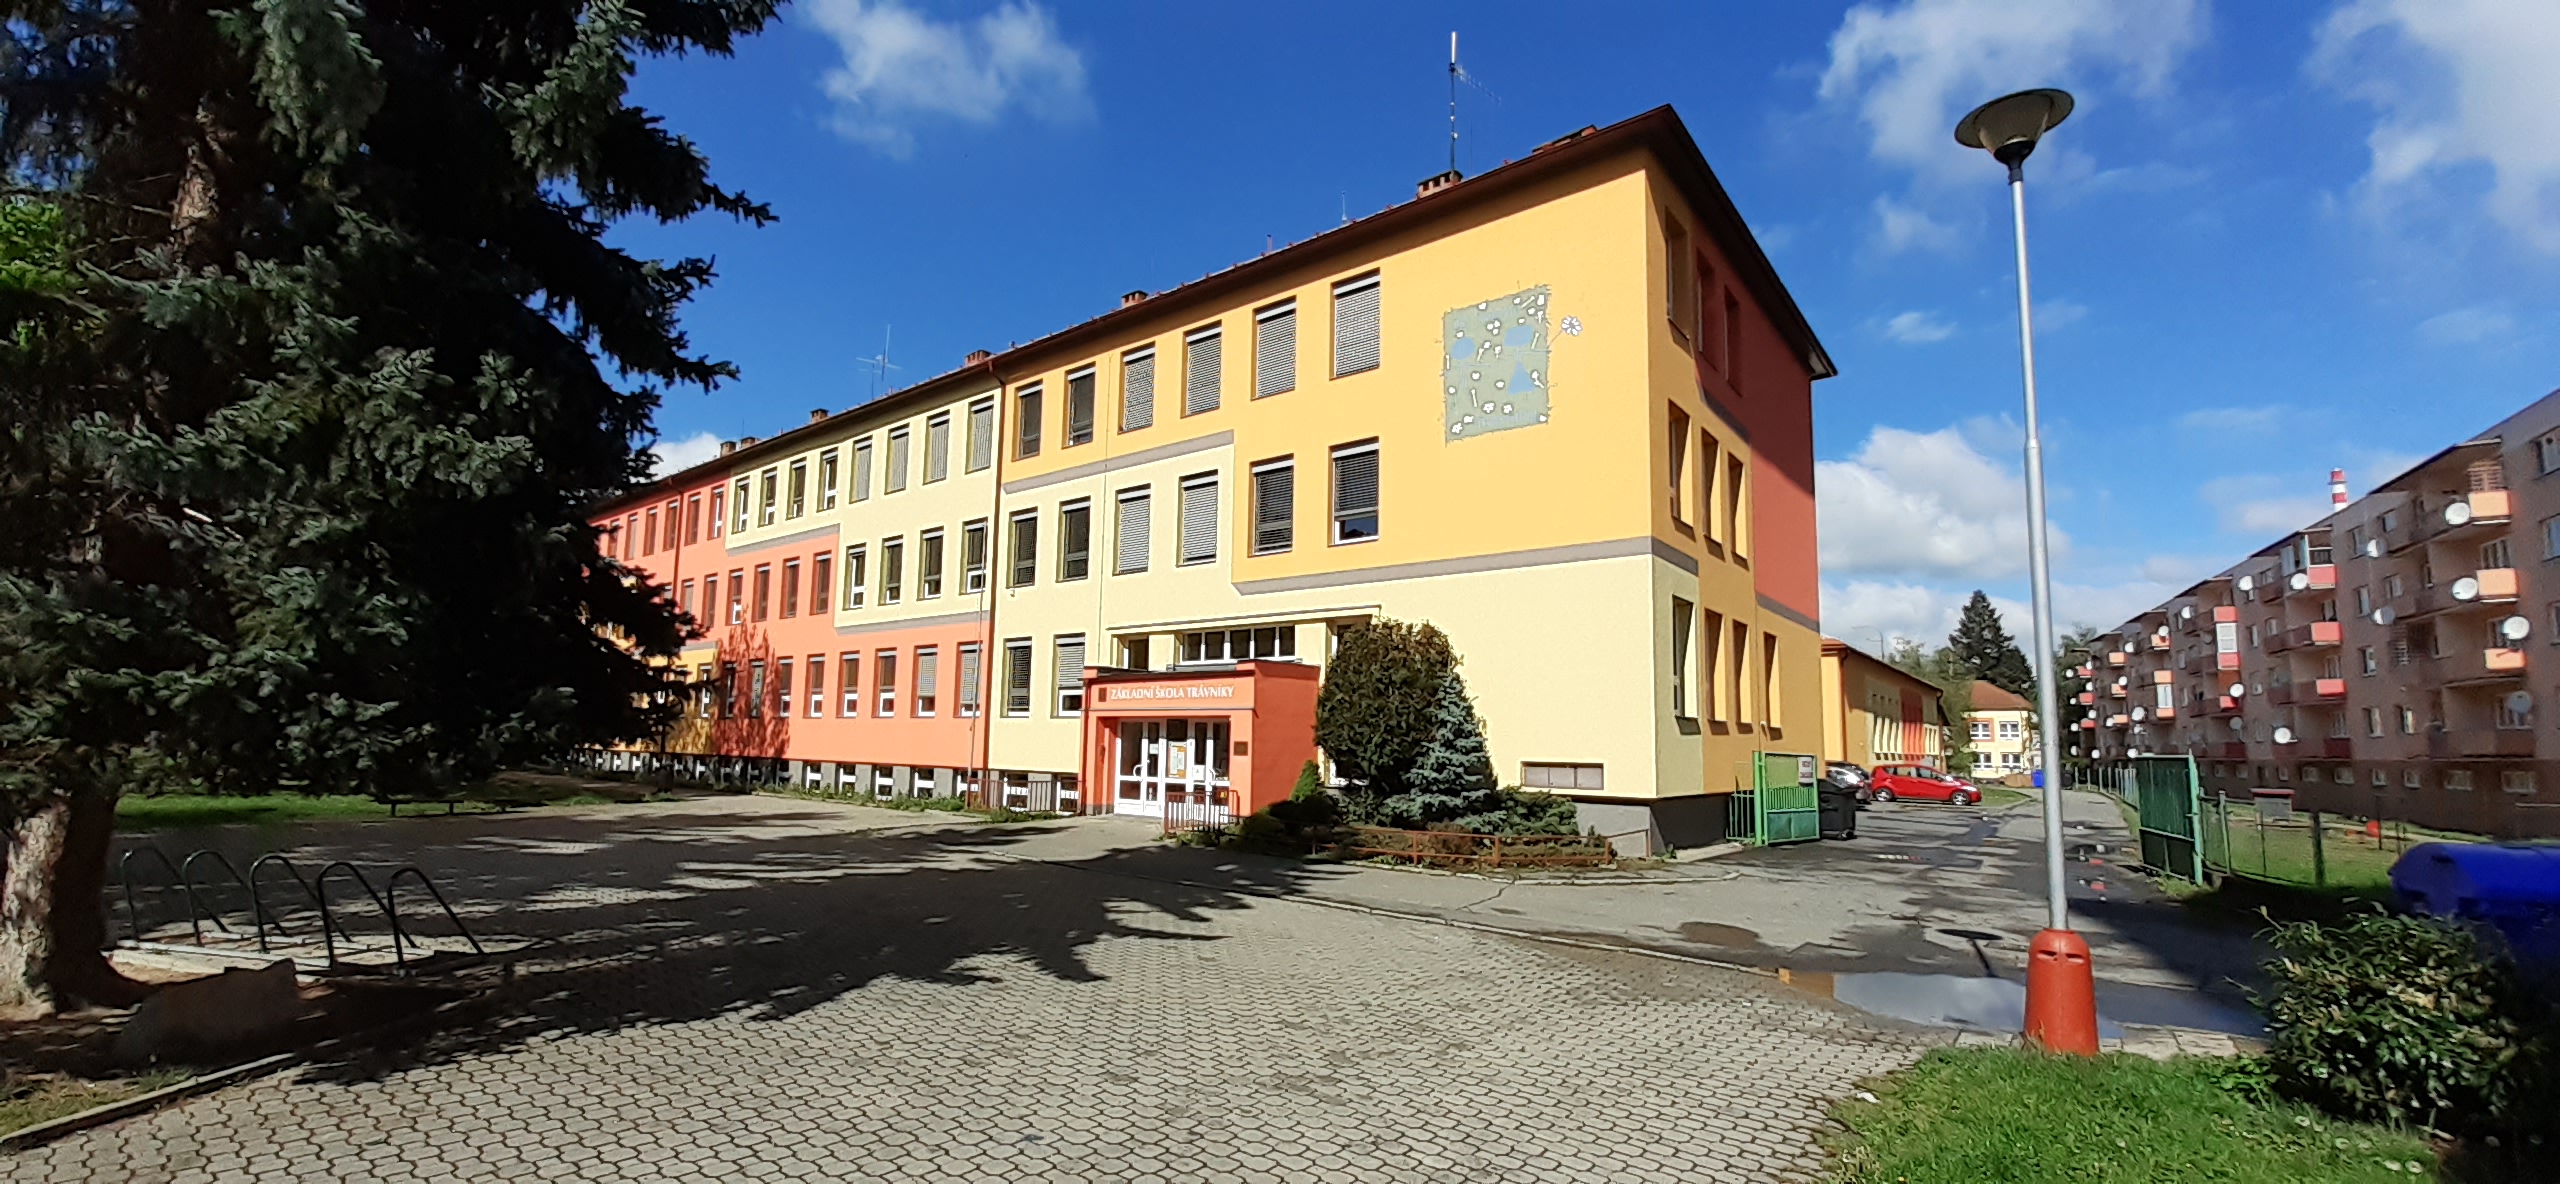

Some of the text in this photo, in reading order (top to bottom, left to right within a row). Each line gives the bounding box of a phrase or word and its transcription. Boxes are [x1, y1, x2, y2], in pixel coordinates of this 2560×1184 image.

[1110, 684, 1235, 700] ZÁKLADNÍ ŠKOLA TRÁVNÍKY
